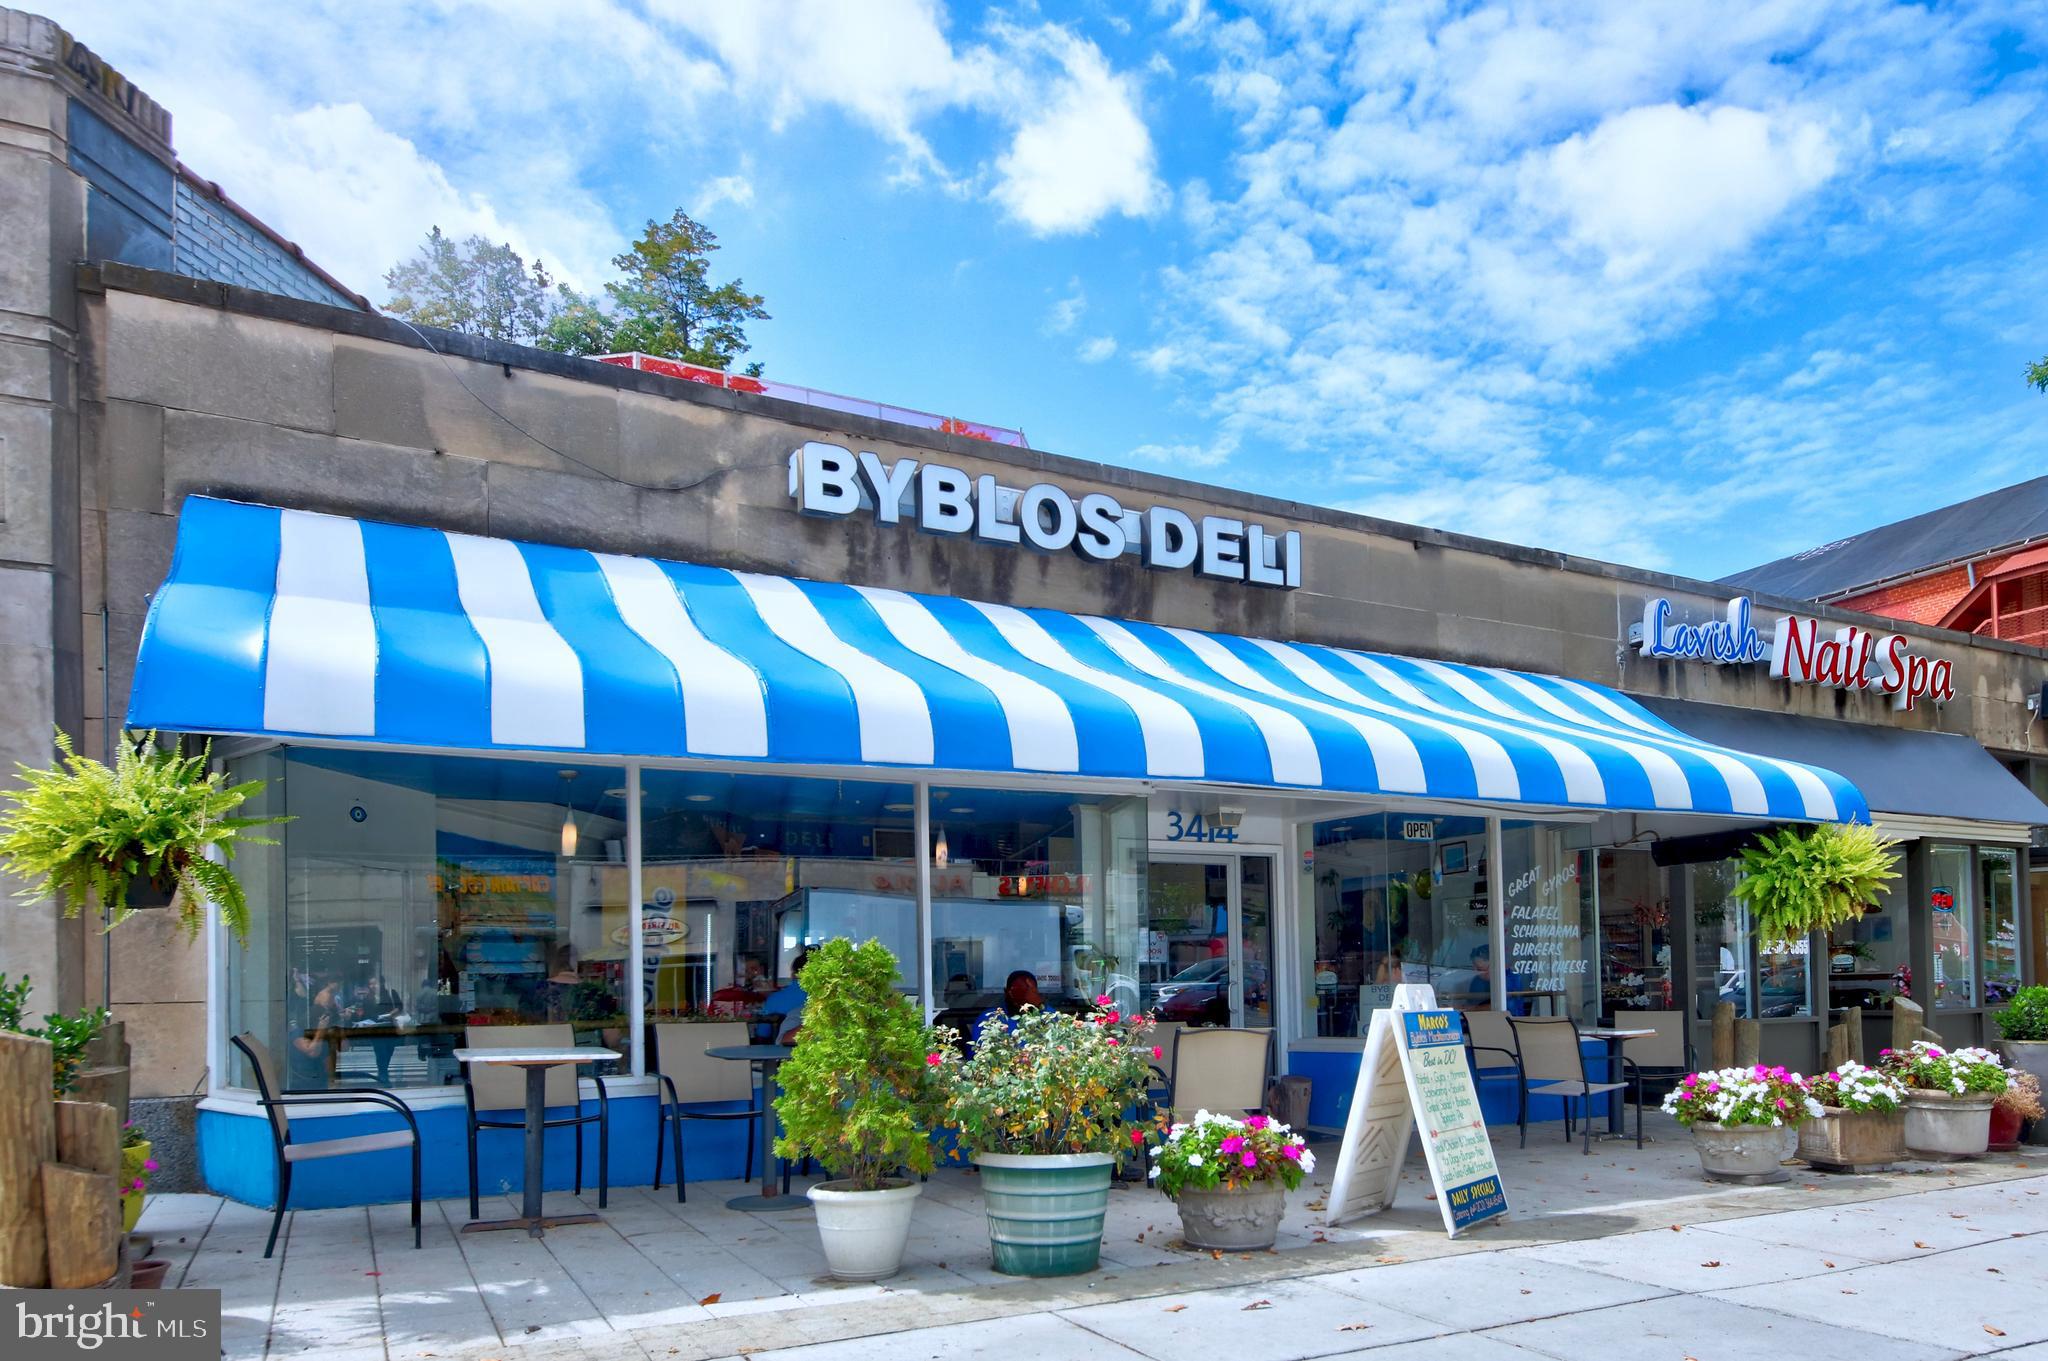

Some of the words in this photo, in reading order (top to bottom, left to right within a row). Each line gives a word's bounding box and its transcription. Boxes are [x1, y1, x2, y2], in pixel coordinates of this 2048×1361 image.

[802, 441, 1126, 561] BYBLOS
[1146, 505, 1302, 590] DELI
[1650, 596, 1766, 663] Lavish
[1780, 615, 1873, 690] Nail
[1881, 634, 1955, 712] Spa
[1167, 811, 1239, 843] 3414
[1406, 822, 1431, 838] OPEN
[1508, 865, 1541, 897] GREAT
[1542, 864, 1577, 896] GYROS
[1511, 905, 1561, 920] FALAFEL
[1511, 924, 1579, 939] SCHAWARMA
[1512, 942, 1564, 957] BURGERS
[1535, 977, 1566, 992] FRIES
[1417, 1013, 1449, 1031] MARCO'S
[1451, 1188, 1469, 1207] DAILY
[1470, 1179, 1496, 1200] SPECIALS
